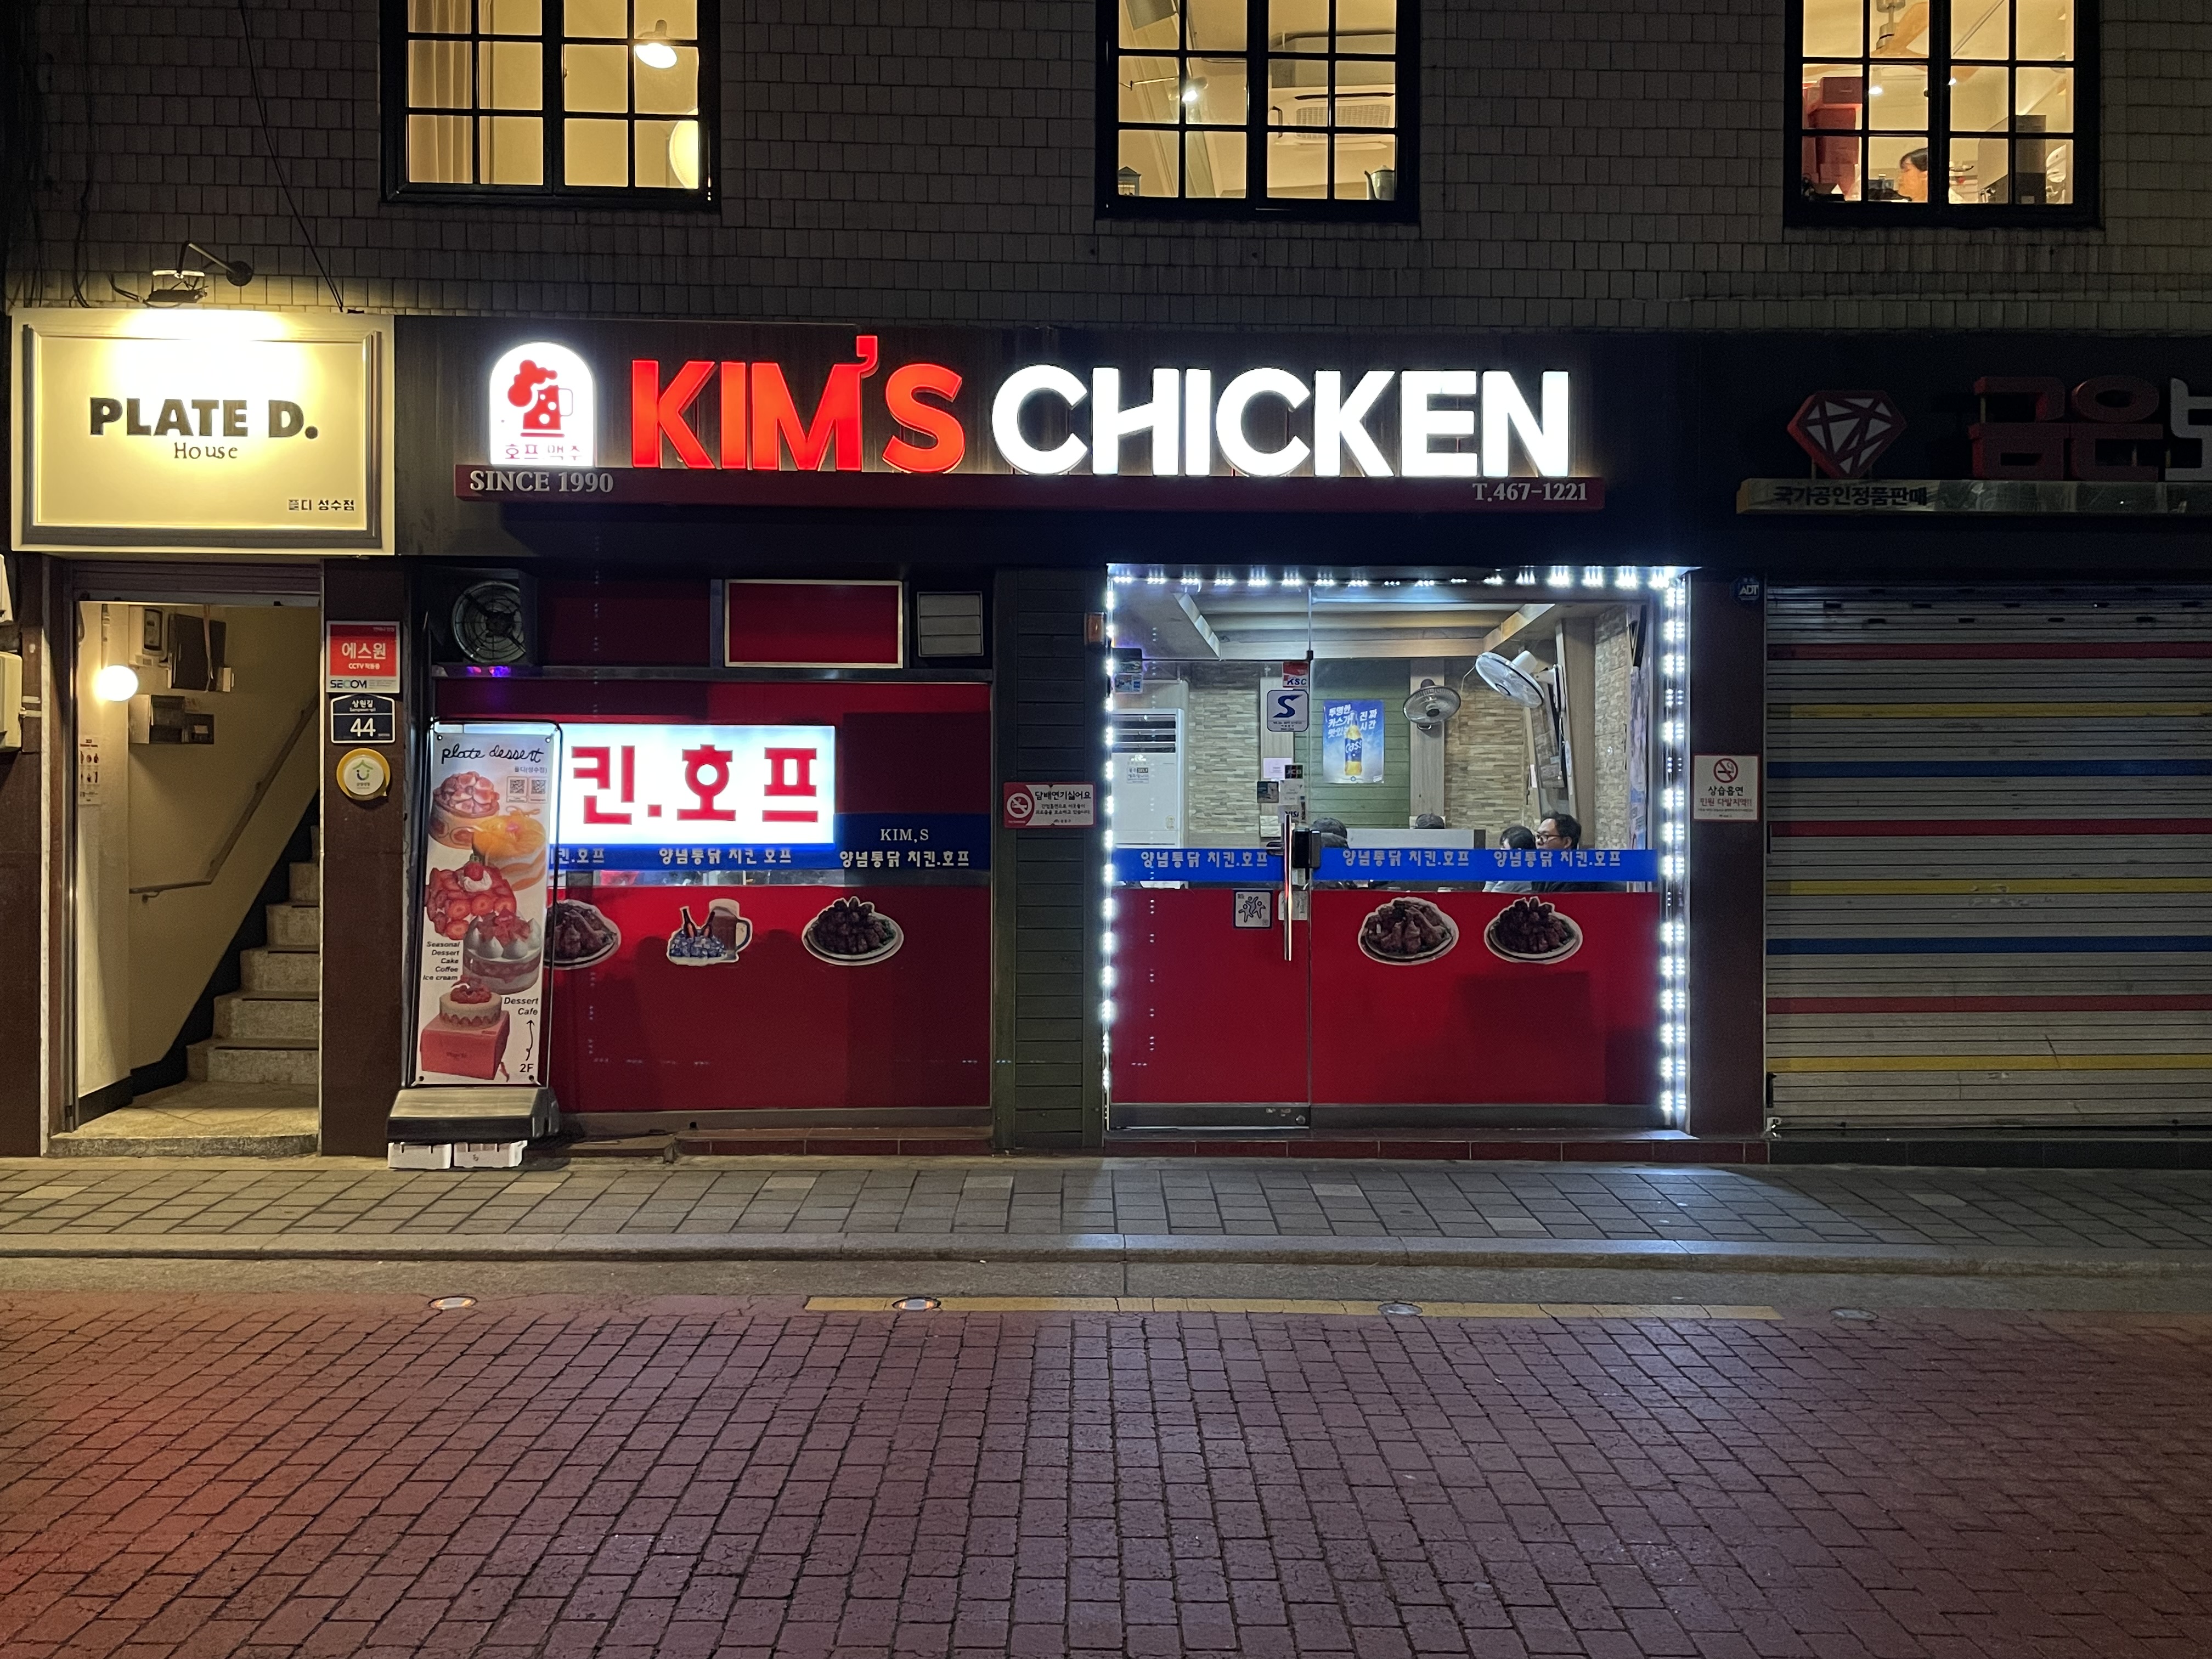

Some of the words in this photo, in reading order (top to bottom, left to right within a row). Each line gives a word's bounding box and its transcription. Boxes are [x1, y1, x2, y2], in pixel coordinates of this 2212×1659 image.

[631, 335, 965, 473] KIM'S
[991, 364, 1571, 478] CHICKEN
[89, 397, 248, 437] PLATE
[268, 399, 319, 439] D.
[174, 442, 238, 459] House
[505, 444, 538, 460] 호프
[548, 445, 582, 461] 맥주
[469, 470, 550, 492] SINCE
[558, 472, 614, 493] 1990
[1473, 483, 1588, 503] T.467-1221
[1774, 486, 1927, 506] 국가공인정품판매
[318, 499, 354, 511] 성수점
[1739, 585, 1759, 595] ADT
[341, 642, 386, 660] 에스원
[330, 680, 367, 689] SECOM
[352, 699, 374, 708] 상원길
[1328, 704, 1352, 717] 투명한
[350, 718, 376, 737] 44
[1328, 713, 1354, 728] 카스가
[442, 743, 485, 764] plate
[489, 744, 544, 763] dessert
[1035, 791, 1092, 800] 담배연기싫어요
[1708, 786, 1743, 796] 상습흡연
[1700, 798, 1715, 806] 민원
[880, 829, 929, 843] KIM,S
[658, 848, 721, 865] 양념통닭
[764, 849, 792, 863] 호프
[839, 850, 900, 868] 양념통닭
[1141, 851, 1200, 868] 양념통닭
[1342, 850, 1401, 866] 양념통닭
[1493, 851, 1553, 867] 양념통닭
[519, 1063, 534, 1073] 2F
